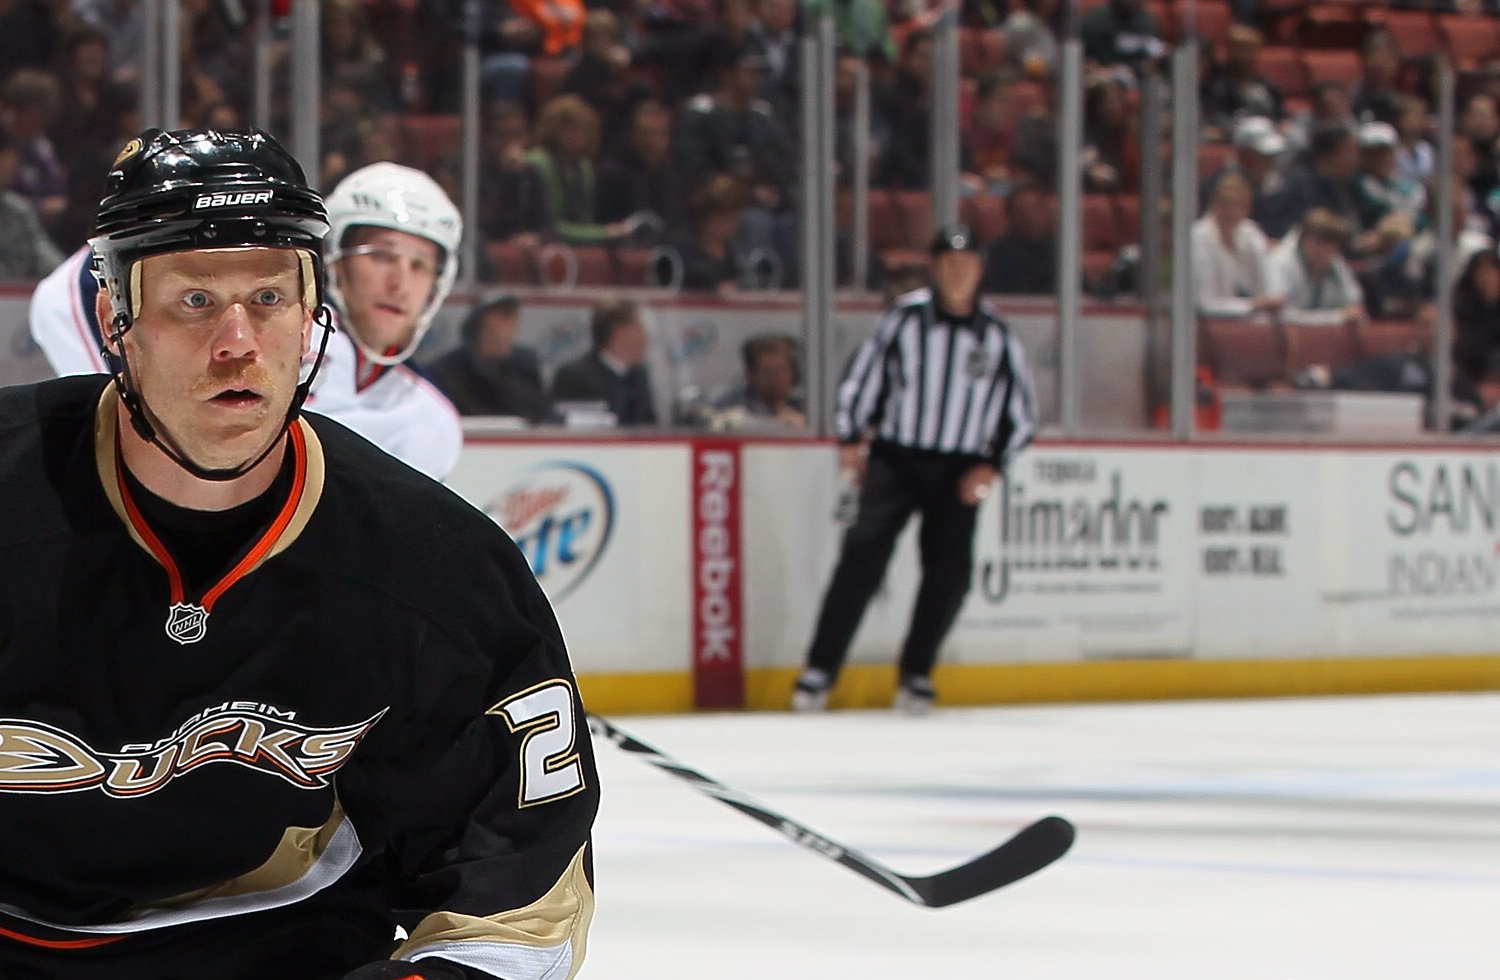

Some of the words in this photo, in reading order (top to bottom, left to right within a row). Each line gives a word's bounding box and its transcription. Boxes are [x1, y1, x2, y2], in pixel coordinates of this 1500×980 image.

[195, 190, 273, 209] BAUER
[700, 451, 735, 663] Reebok
[174, 615, 201, 634] NHL
[484, 678, 587, 809] 2
